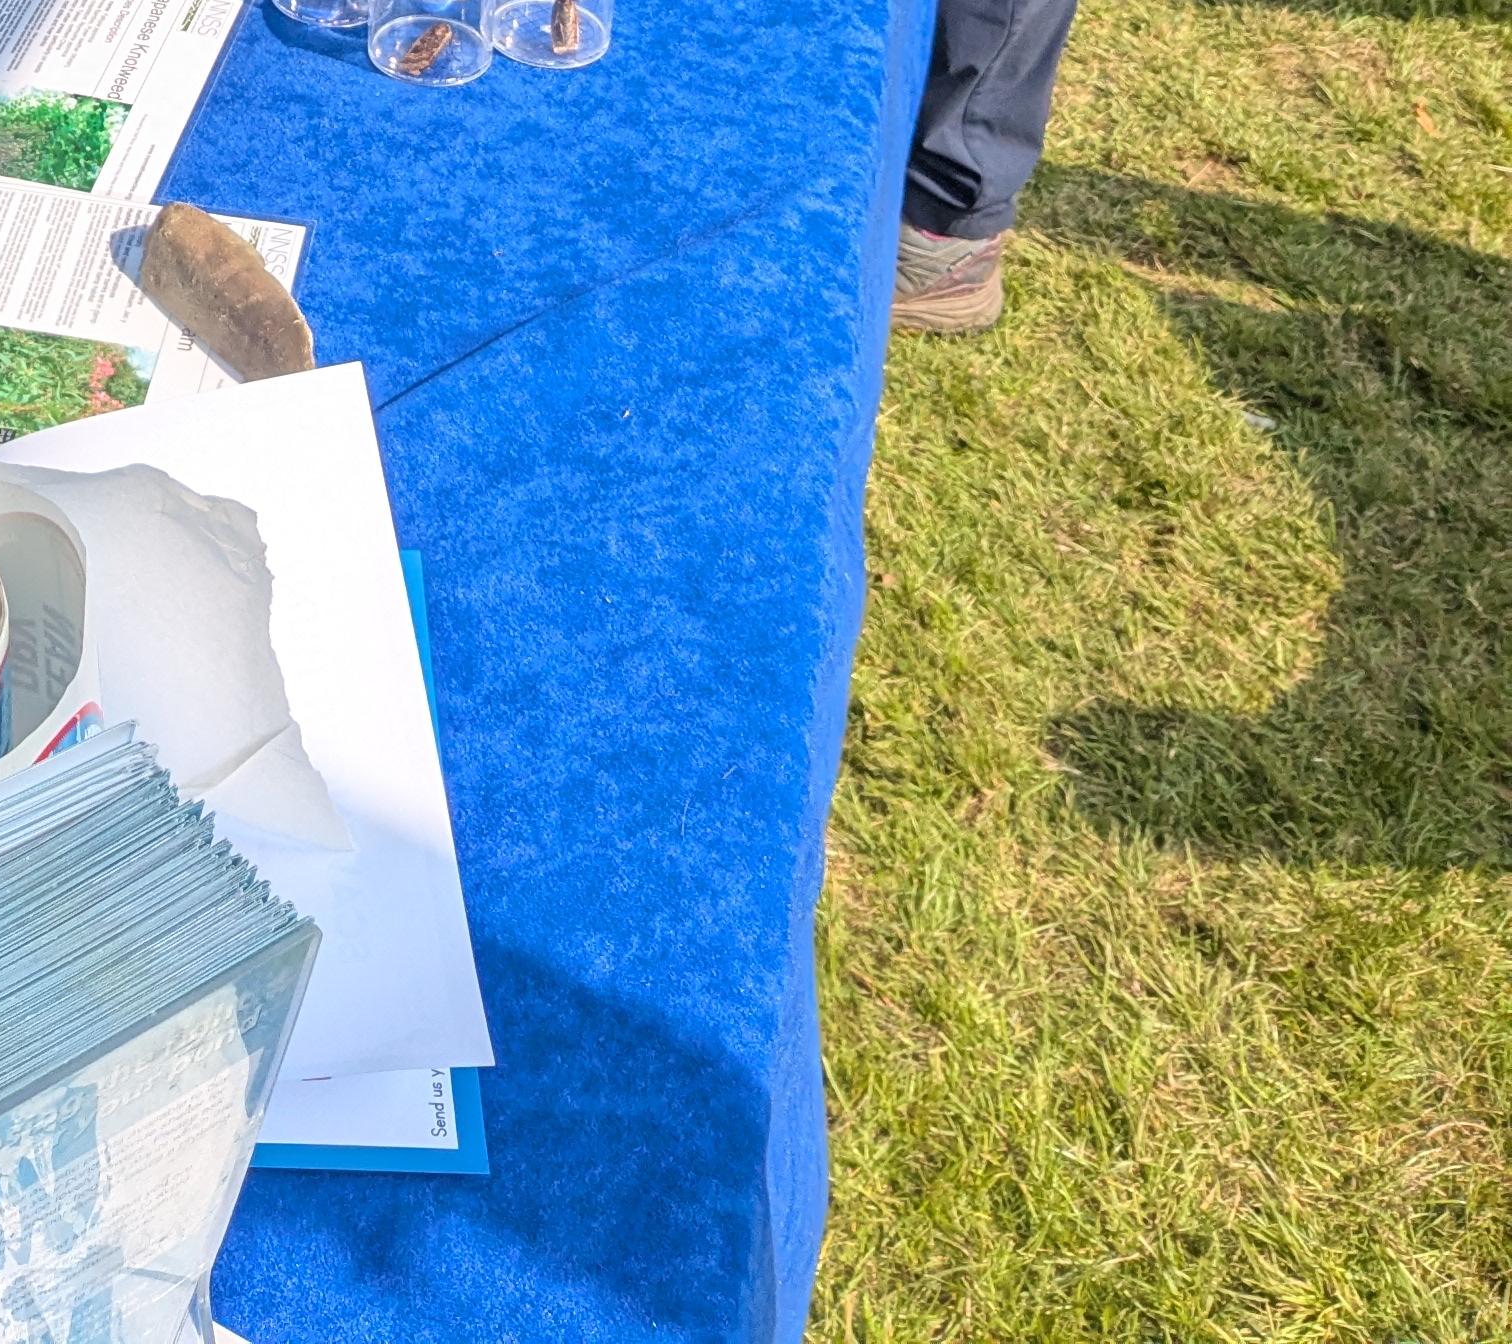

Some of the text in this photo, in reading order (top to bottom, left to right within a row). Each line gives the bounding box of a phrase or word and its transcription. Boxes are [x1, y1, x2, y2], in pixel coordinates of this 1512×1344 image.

[103, 8, 130, 45] Description
[106, 41, 149, 102] Knotweed
[260, 225, 294, 276] NNSS
[433, 1082, 444, 1098] us
[431, 1100, 448, 1138] Send
